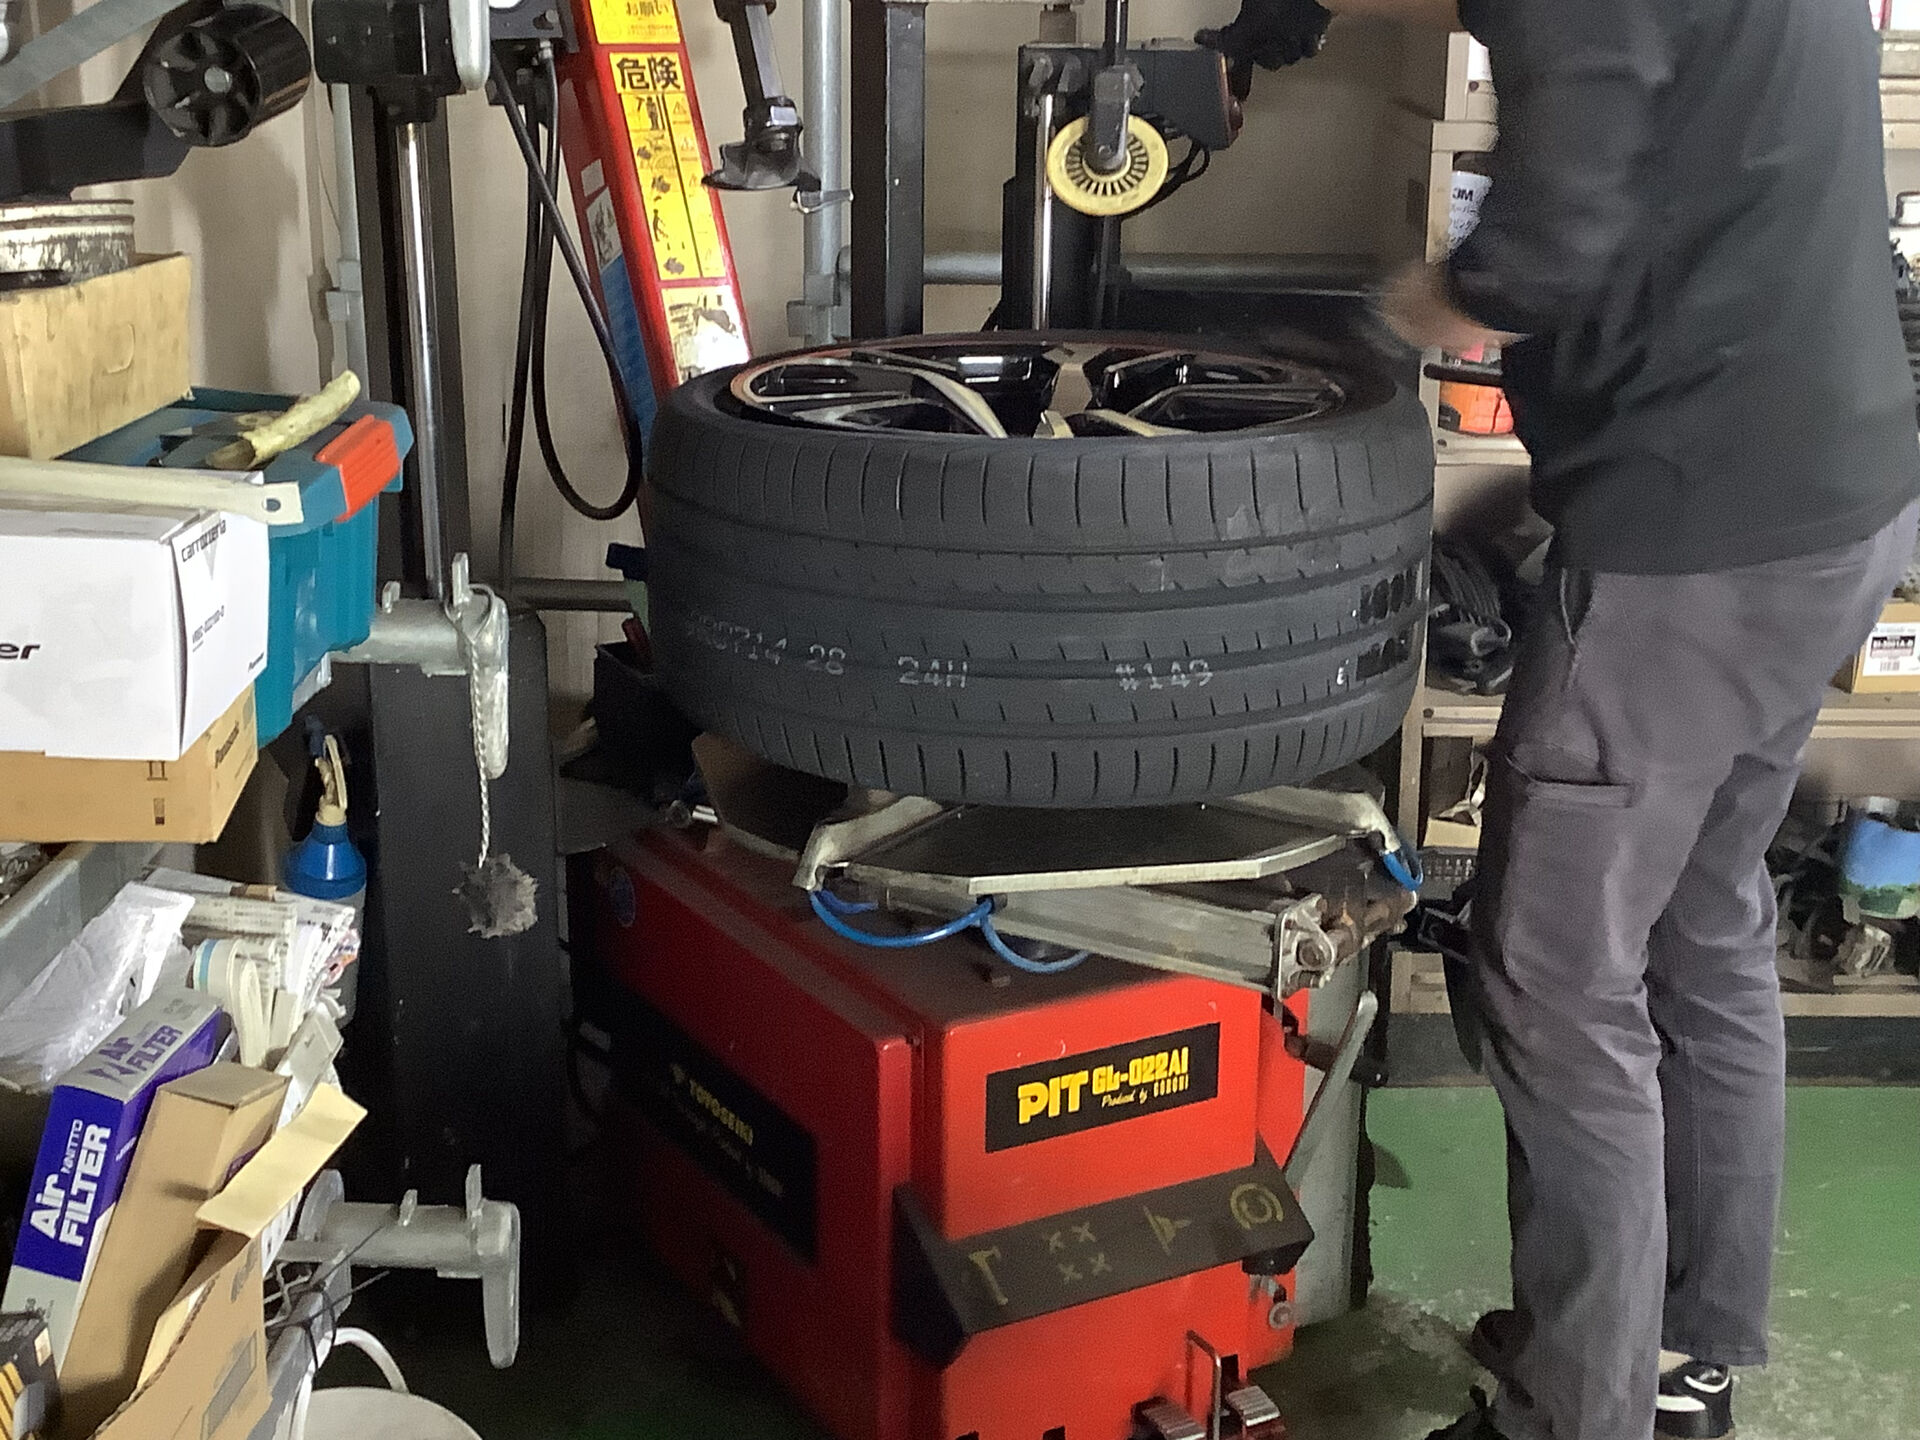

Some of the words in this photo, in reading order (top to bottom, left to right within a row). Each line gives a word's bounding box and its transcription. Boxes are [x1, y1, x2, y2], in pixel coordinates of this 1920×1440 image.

[616, 56, 680, 90] 危険
[99, 1037, 135, 1061] Air
[126, 1025, 183, 1072] FILTER
[1017, 1070, 1089, 1125] PIT
[30, 1174, 66, 1239] Air
[59, 1124, 111, 1247] FILTER
